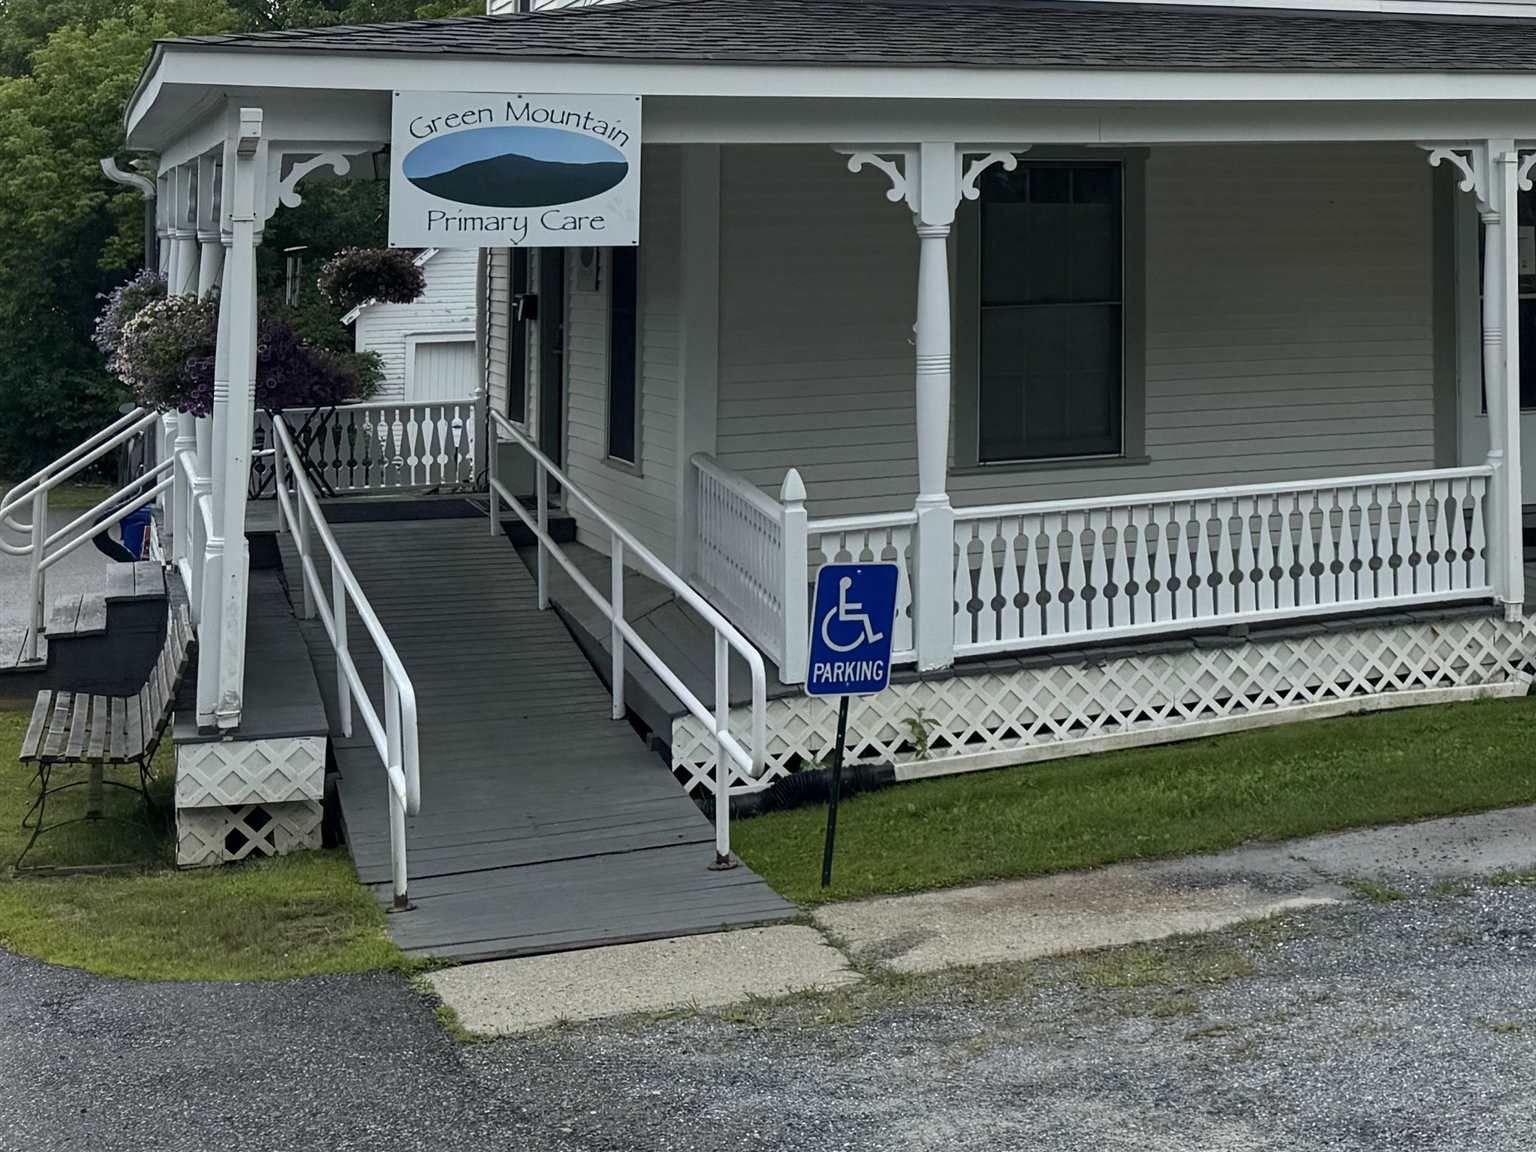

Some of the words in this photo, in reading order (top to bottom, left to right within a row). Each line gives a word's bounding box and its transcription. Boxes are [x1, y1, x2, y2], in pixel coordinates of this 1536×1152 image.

[409, 107, 494, 139] Green
[505, 101, 630, 147] Mountain
[427, 209, 528, 245] Primary
[540, 209, 606, 231] Care
[812, 660, 884, 684] PARKING
